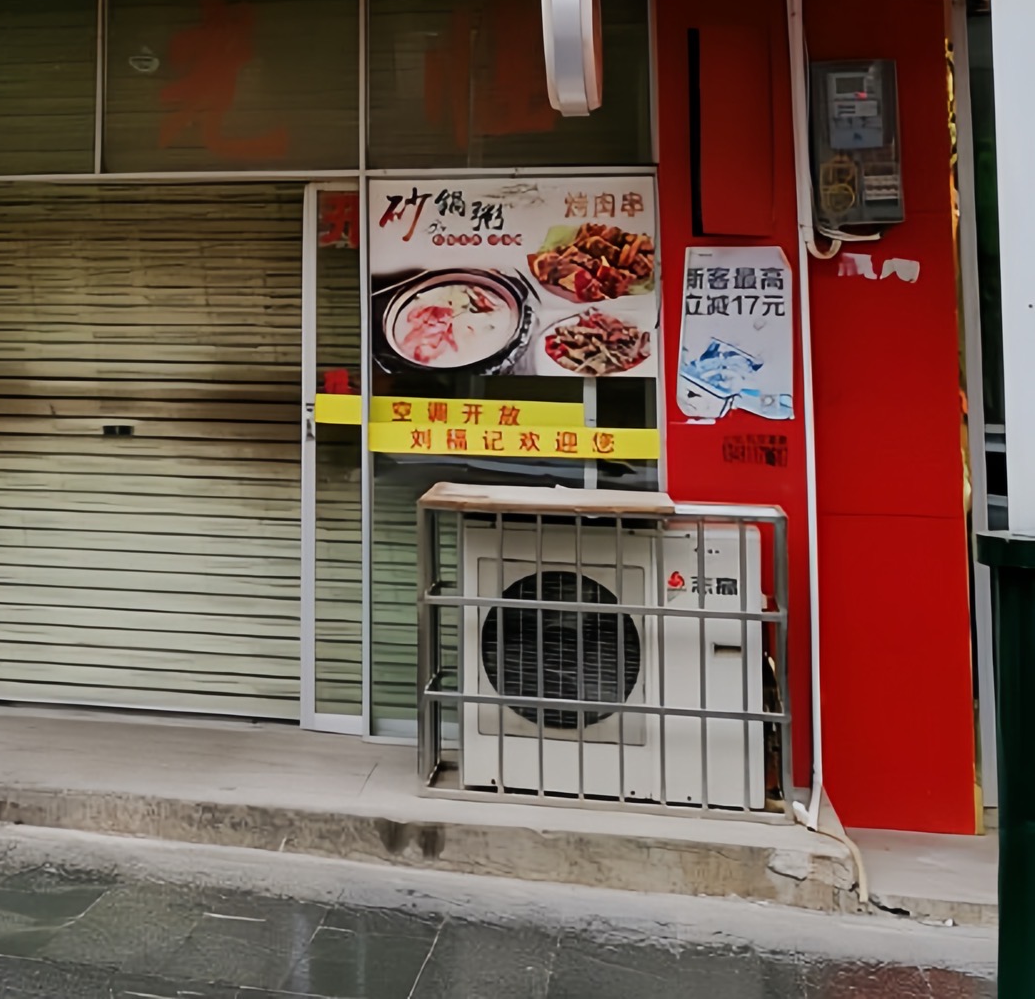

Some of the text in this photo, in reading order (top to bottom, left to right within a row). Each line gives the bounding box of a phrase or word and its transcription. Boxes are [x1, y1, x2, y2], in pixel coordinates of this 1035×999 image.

[379, 187, 505, 242] 砂锅粥
[392, 401, 521, 426] 空调开放
[411, 428, 615, 453] 刘福记欢迎您
